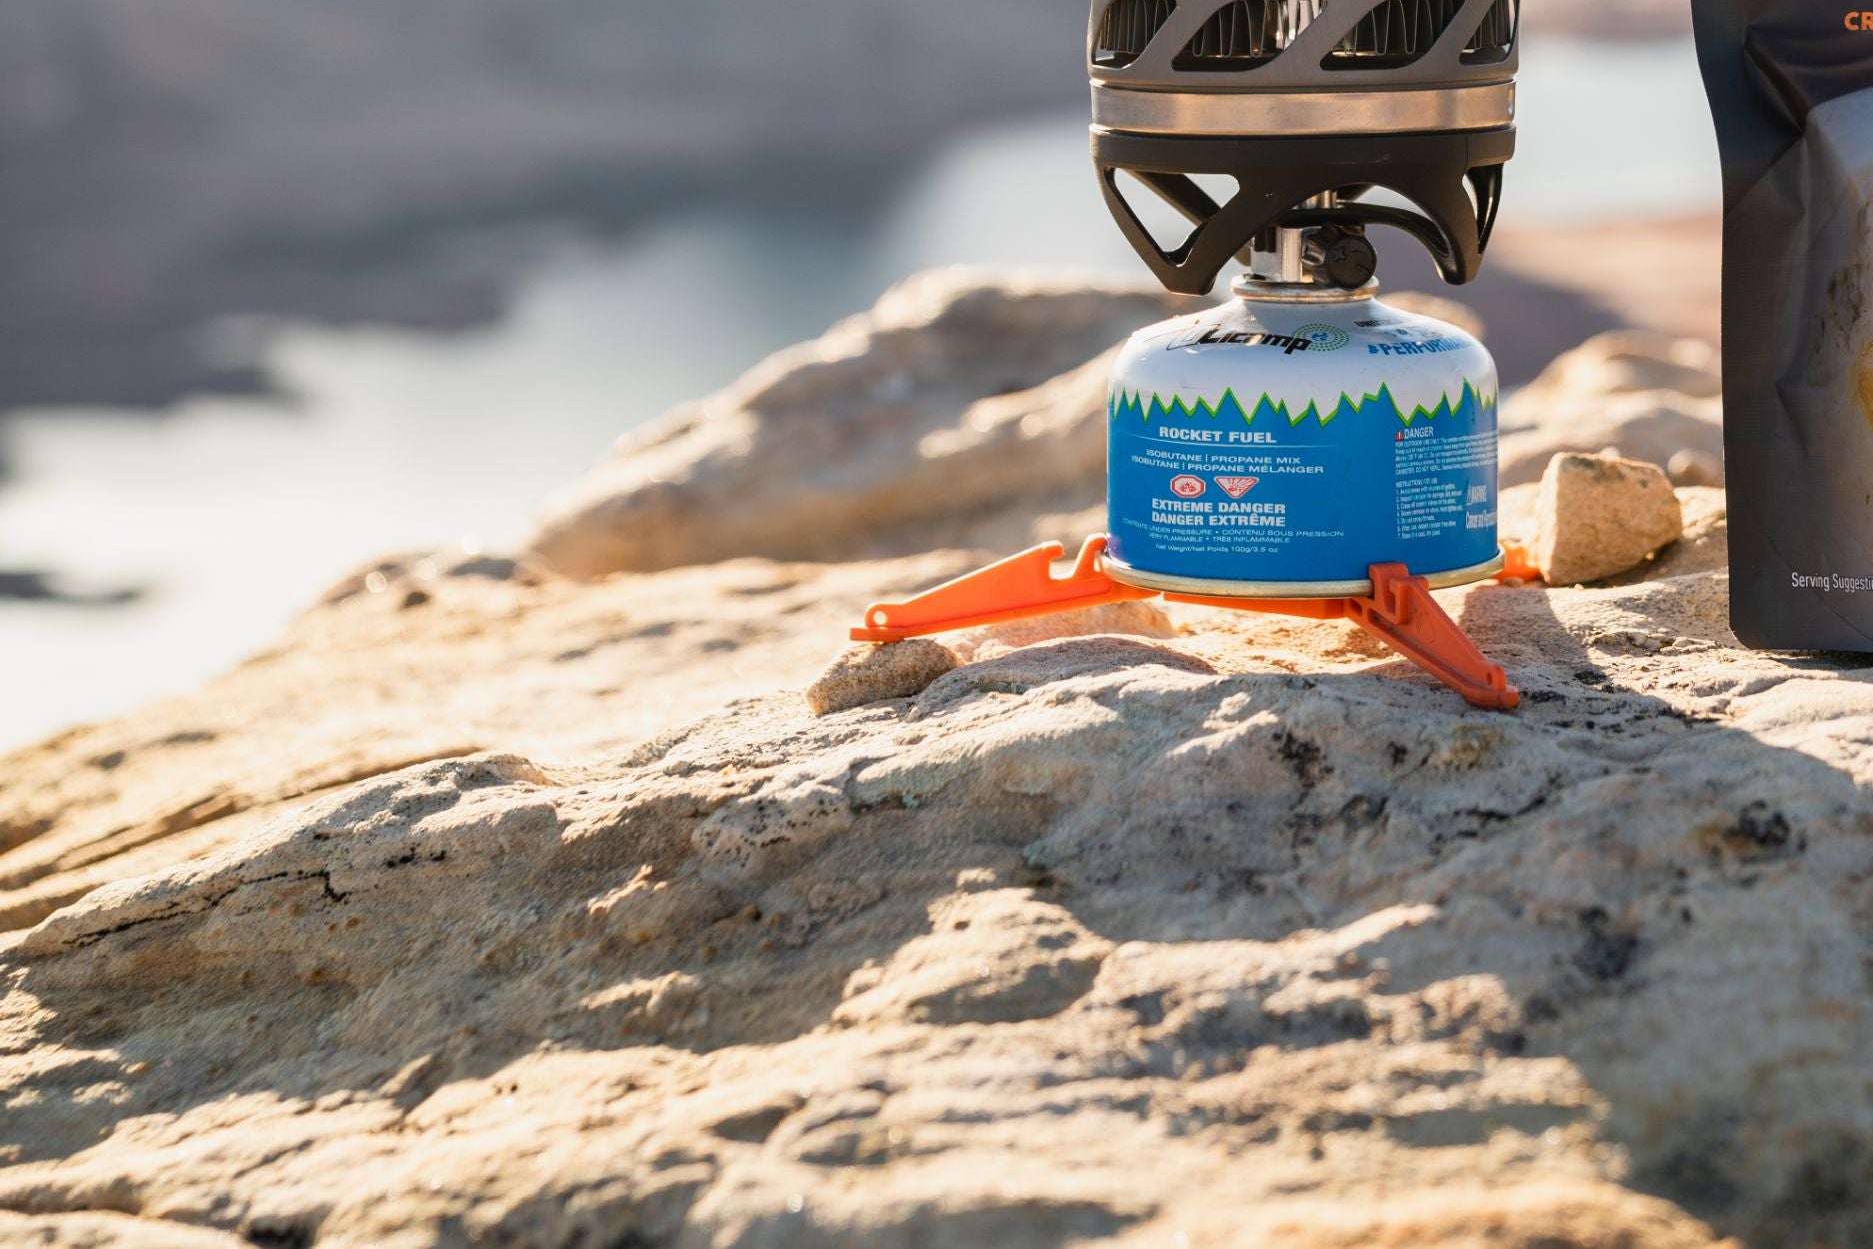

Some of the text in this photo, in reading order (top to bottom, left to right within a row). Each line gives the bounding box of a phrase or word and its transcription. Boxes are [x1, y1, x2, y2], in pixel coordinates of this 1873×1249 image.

[1159, 426, 1277, 443] ROCKET FUEL
[1404, 426, 1434, 439] DANGER
[1131, 455, 1324, 474] ISOBUTANE PROPANE MÉLANGER
[1146, 449, 1202, 462] ISOBUTANE
[1211, 455, 1272, 464] PROPANE
[1151, 498, 1286, 514] EXTREME DANGER
[1151, 511, 1286, 527] DANGER EXTRÊME
[1163, 534, 1203, 542] FLAMMABLE
[1267, 529, 1294, 537] SOUS
[1791, 571, 1830, 592] Serving
